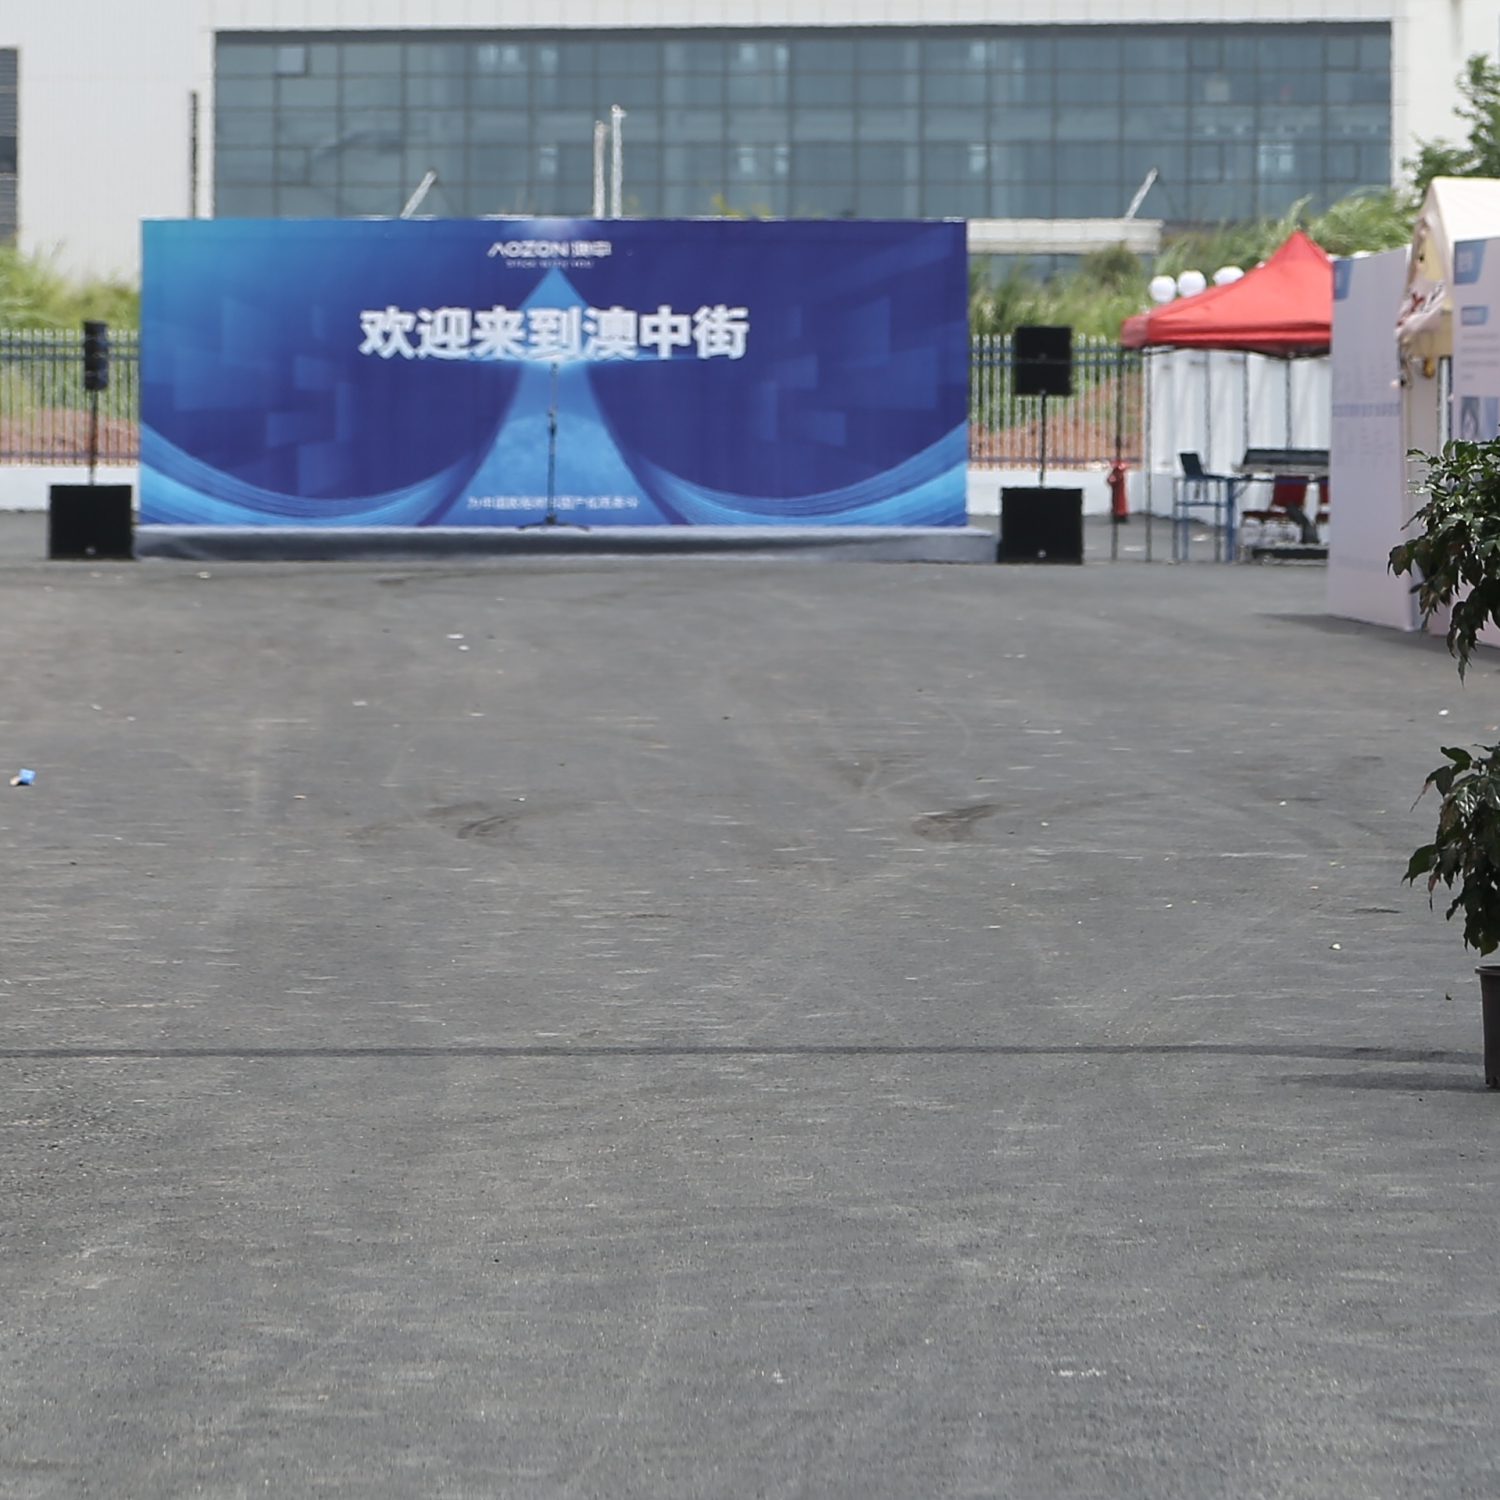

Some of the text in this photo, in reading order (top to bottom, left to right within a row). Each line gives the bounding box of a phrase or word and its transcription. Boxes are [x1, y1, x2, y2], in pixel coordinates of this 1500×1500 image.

[359, 305, 749, 361] 欢迎来到澳中街
